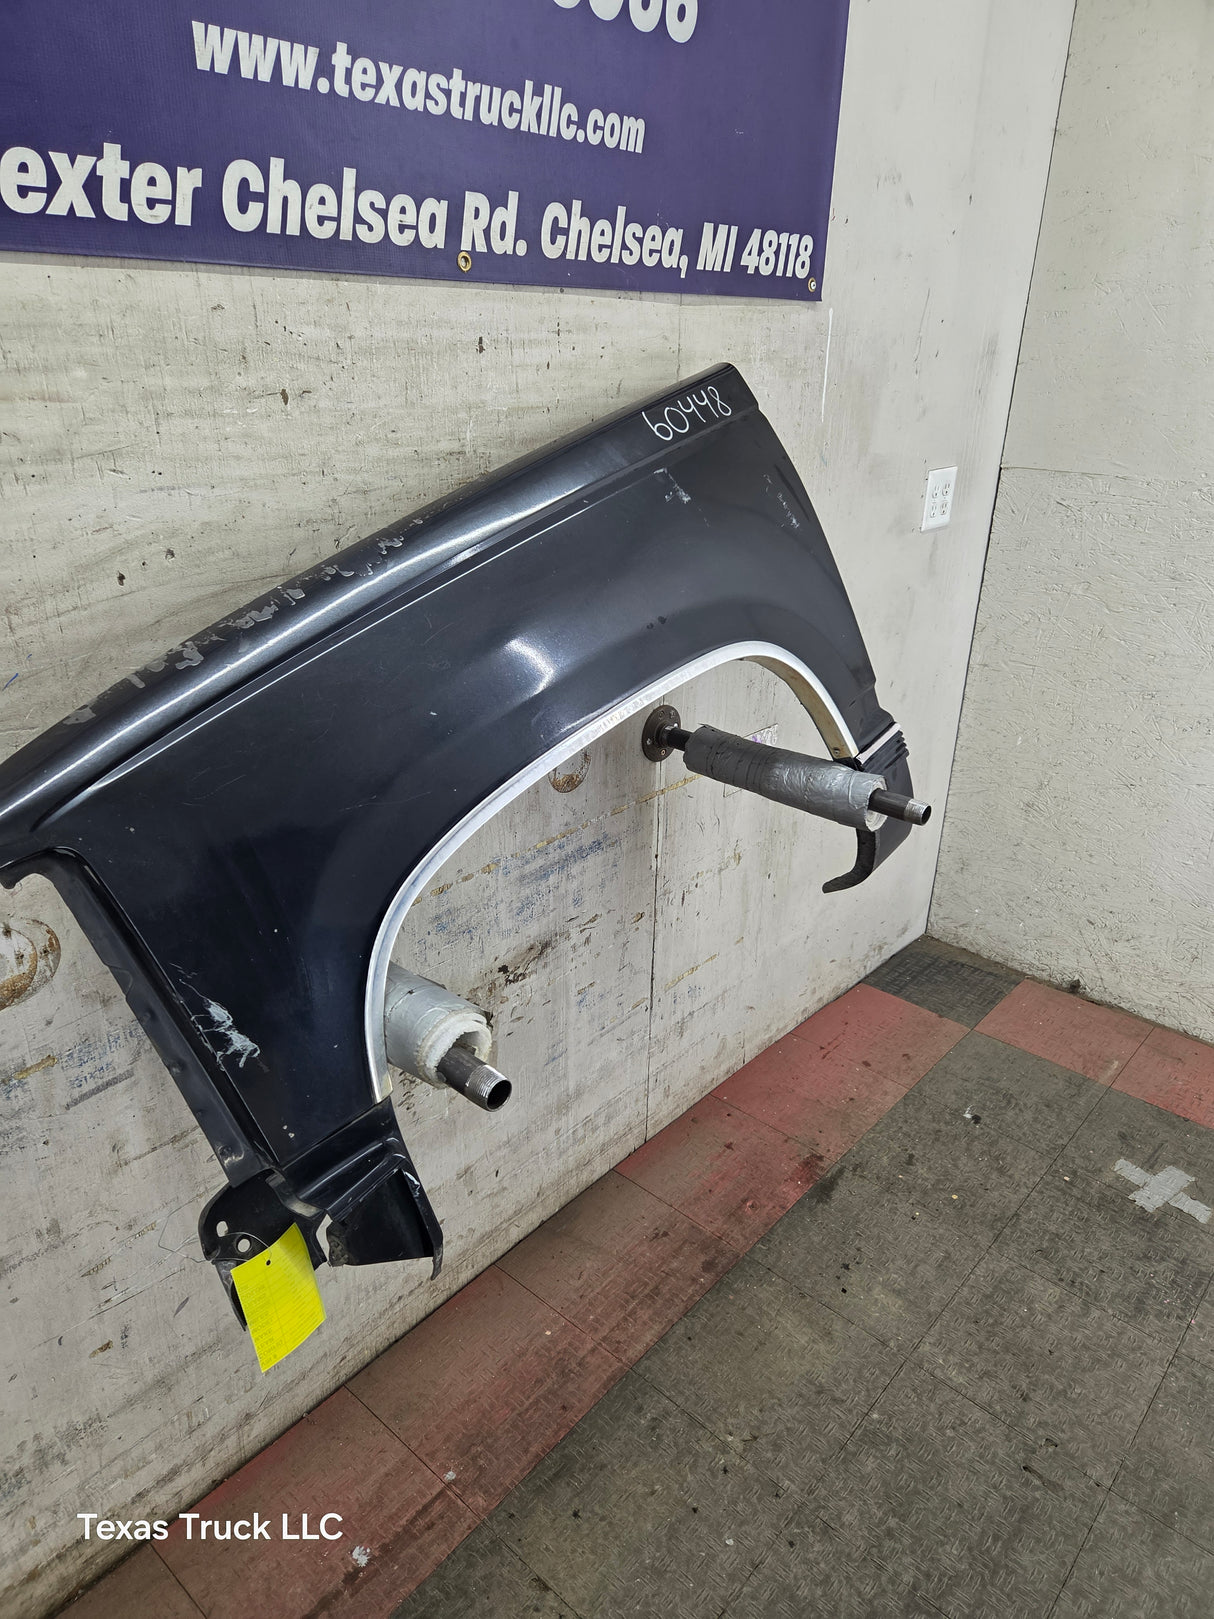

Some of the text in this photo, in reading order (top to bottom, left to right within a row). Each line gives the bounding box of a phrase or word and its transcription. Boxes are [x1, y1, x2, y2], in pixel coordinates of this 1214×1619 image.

[191, 20, 646, 154] www.texastruckllc.com
[222, 156, 449, 249] Chelsea
[460, 190, 528, 257] Rd.
[540, 199, 689, 279] Chelsea,
[696, 221, 739, 273] MI
[740, 228, 814, 279] 48118
[641, 386, 732, 441] 60448
